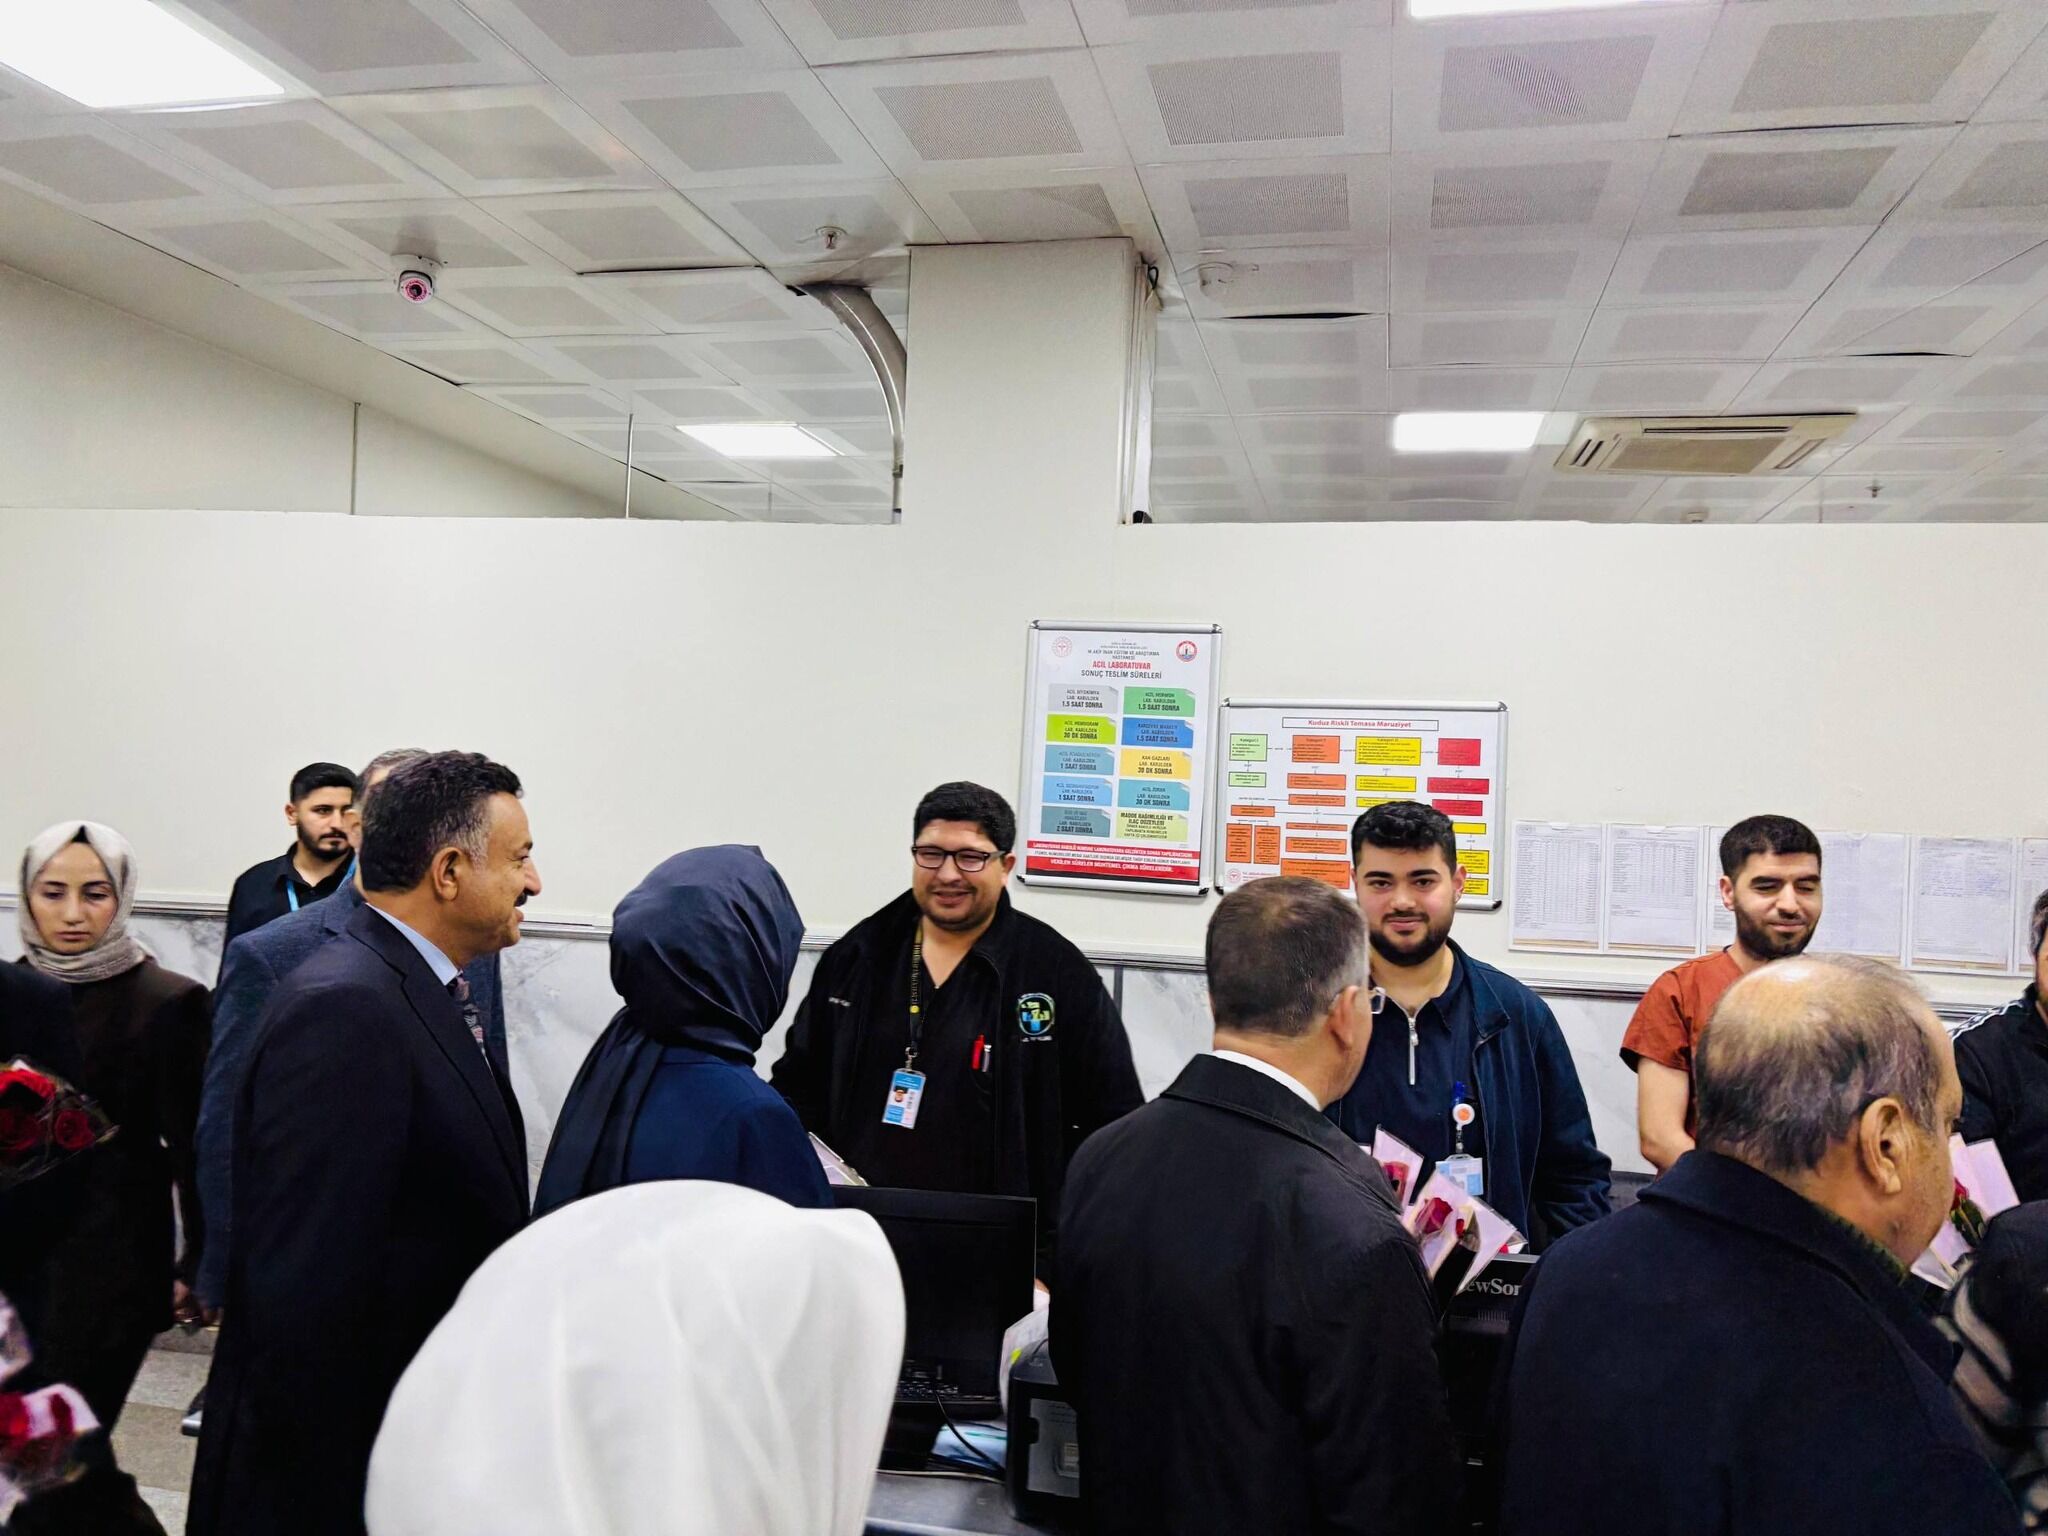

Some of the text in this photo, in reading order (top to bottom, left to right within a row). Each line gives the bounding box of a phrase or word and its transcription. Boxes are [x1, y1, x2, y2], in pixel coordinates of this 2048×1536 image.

[1108, 661, 1150, 670] LABORATUVAR
[1081, 669, 1162, 679] SONUÇ TESLİM SÜRELERİ
